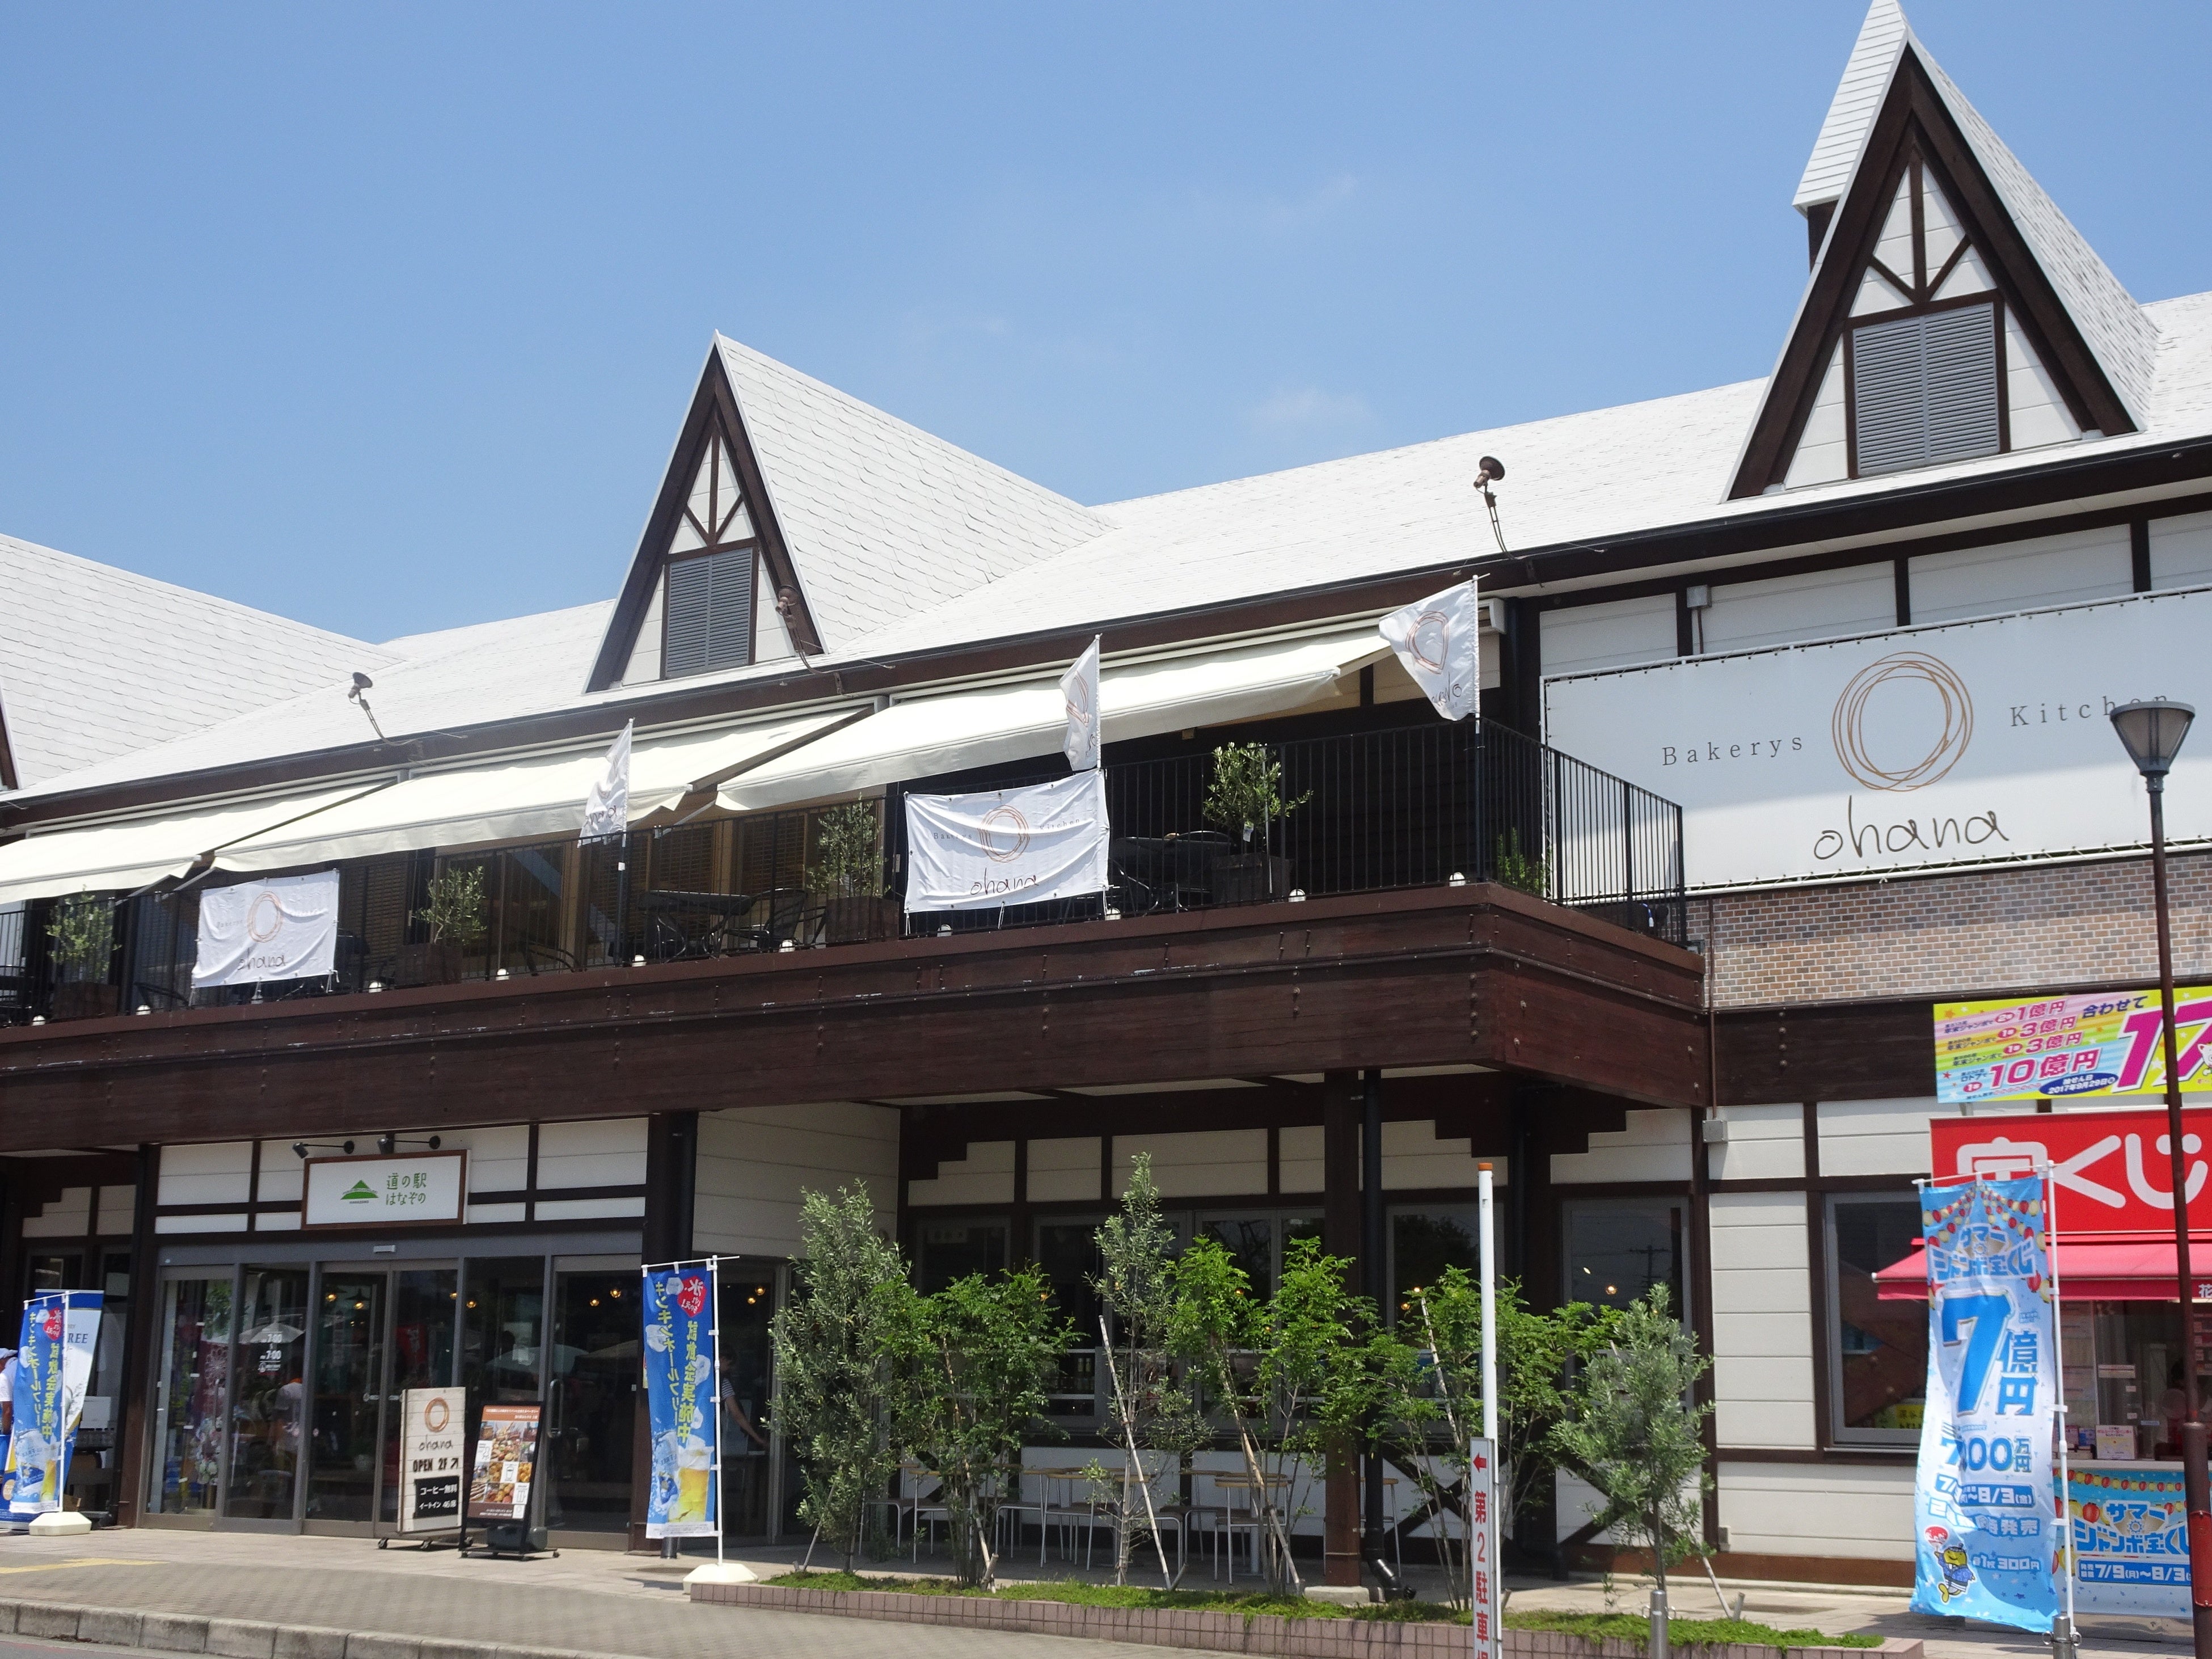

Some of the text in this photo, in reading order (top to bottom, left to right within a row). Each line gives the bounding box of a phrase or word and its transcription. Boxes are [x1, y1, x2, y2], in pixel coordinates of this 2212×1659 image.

[1662, 695, 2167, 766] Bakerys Kitch
[1813, 796, 2010, 859] ohana
[970, 868, 1040, 896] ohana
[237, 948, 288, 970] ohana
[2017, 1001, 2066, 1020] 1億円
[2082, 996, 2148, 1019] 合わせて
[2020, 1016, 2076, 1037] 3億円
[2025, 1032, 2082, 1054] 3億円
[1990, 1049, 2101, 1088] 10億円
[387, 1173, 427, 1190] 道の駅
[386, 1192, 427, 1205] はなぞの
[67, 1333, 88, 1344] REE
[413, 1458, 448, 1473] OPEN 2F
[2106, 1503, 2165, 1523] サマー
[2095, 1564, 2191, 1581] 7/9(月)~8/3(
